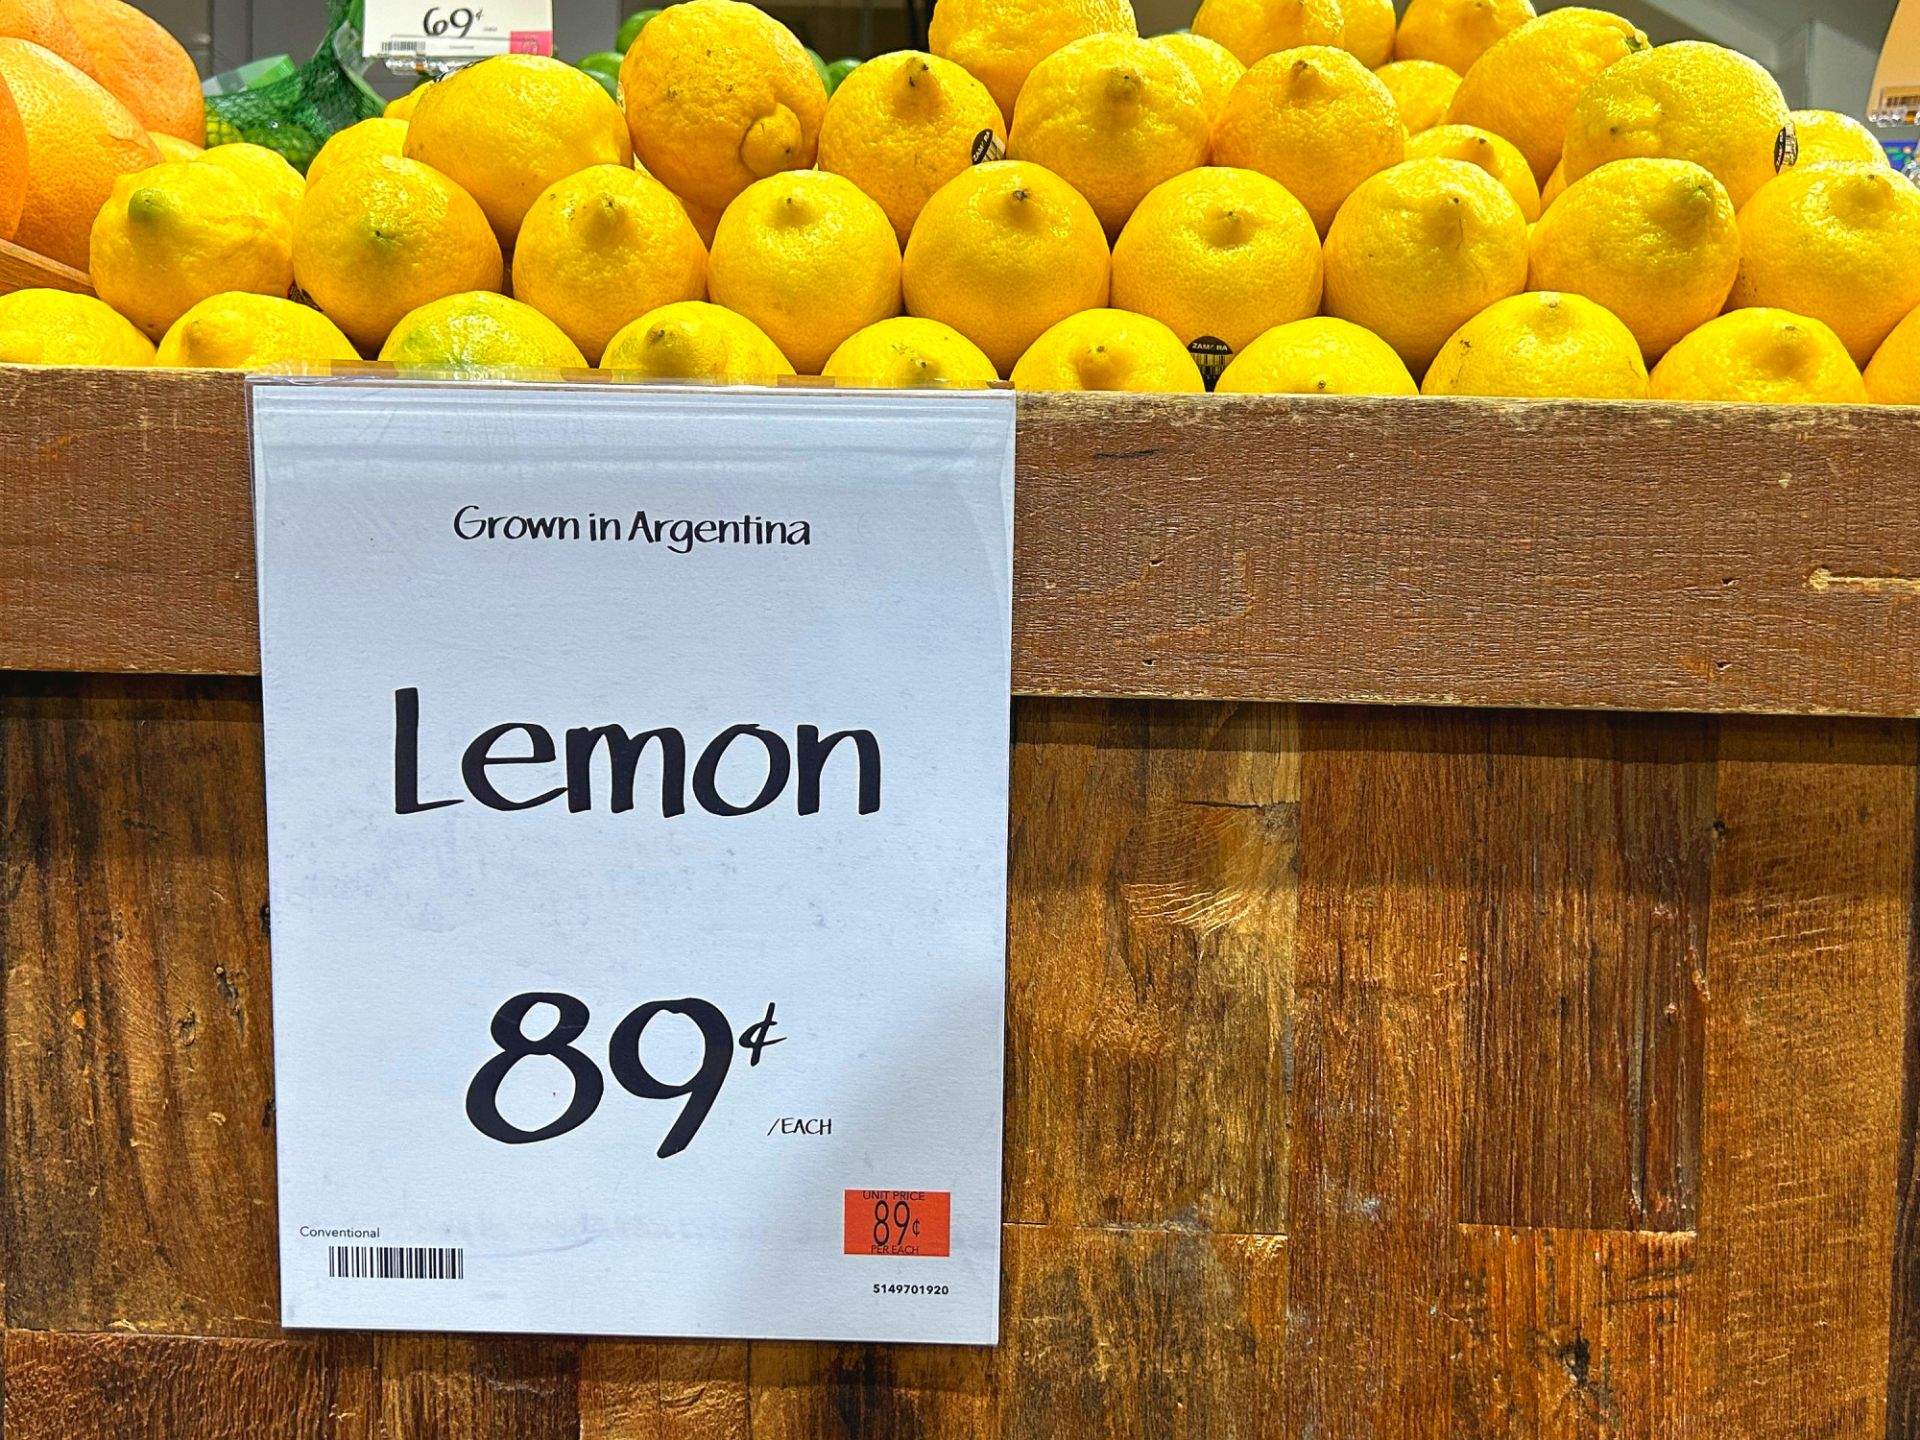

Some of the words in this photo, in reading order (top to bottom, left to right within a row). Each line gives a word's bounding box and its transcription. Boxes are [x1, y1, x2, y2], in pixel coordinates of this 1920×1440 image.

[972, 131, 991, 162] ZAMRA
[1191, 342, 1228, 352] ZAMRA
[453, 505, 580, 540] Grown
[588, 512, 621, 542] in
[628, 510, 811, 554] Argentina
[394, 687, 881, 819] Lemon
[766, 1117, 832, 1137] /EACH
[862, 1190, 890, 1200] UNIT
[892, 1191, 926, 1201] PRICE
[299, 1225, 381, 1239] Conventional
[870, 1244, 889, 1254] PER
[891, 1245, 920, 1255] EACH
[872, 1283, 950, 1295] 5149701920
